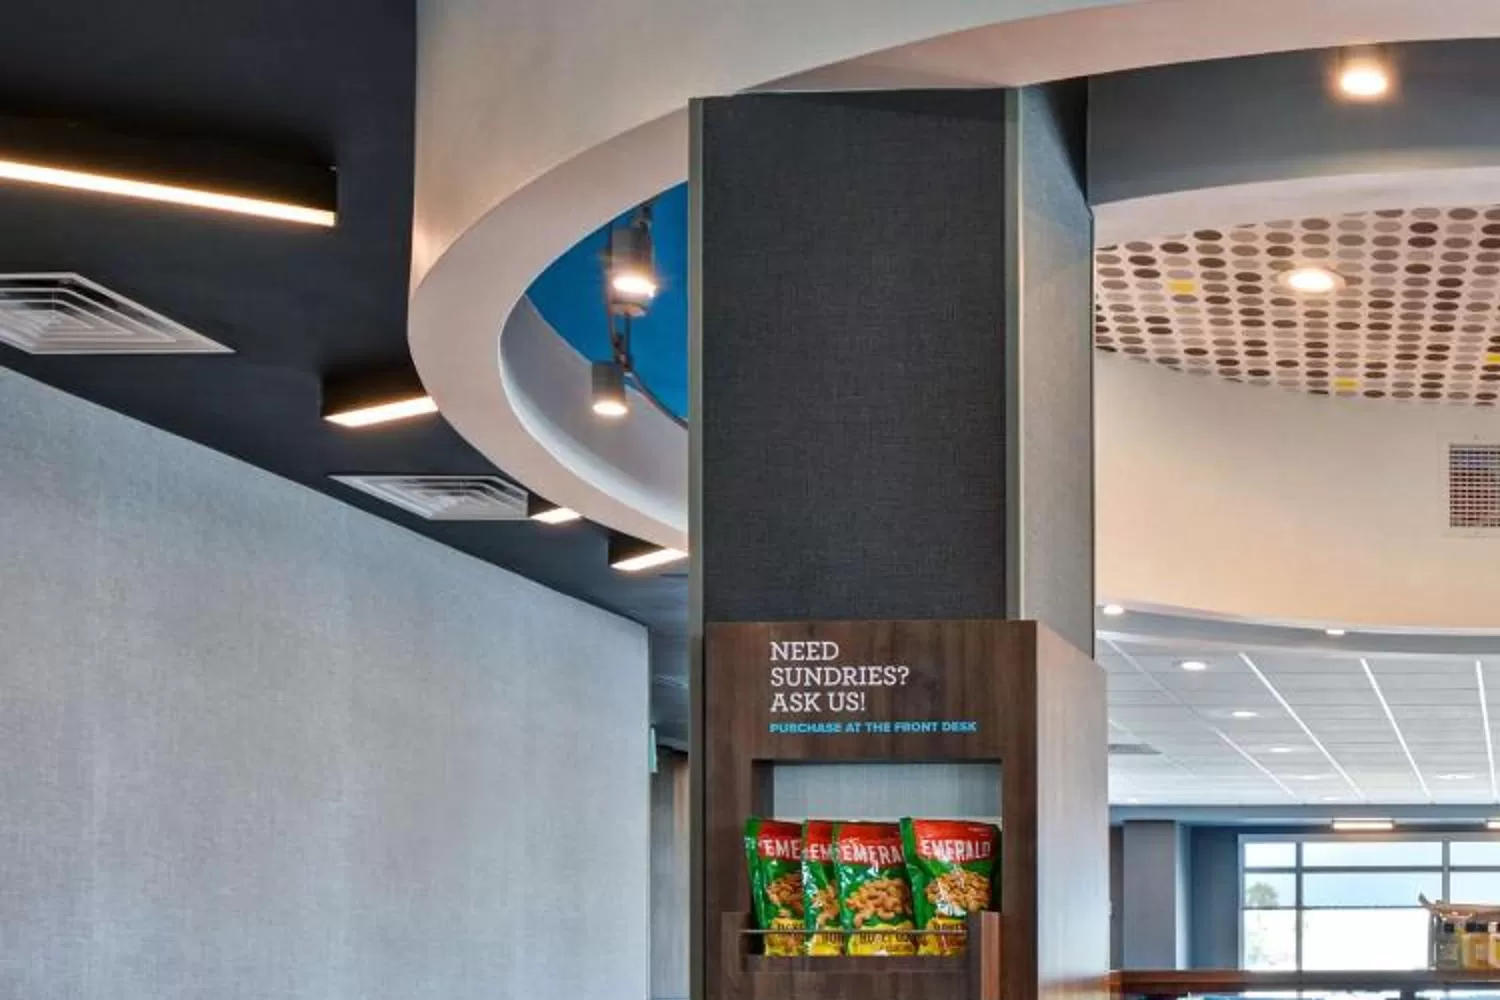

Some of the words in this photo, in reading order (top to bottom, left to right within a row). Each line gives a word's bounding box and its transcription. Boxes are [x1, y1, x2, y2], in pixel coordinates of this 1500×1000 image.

[769, 641, 840, 662] NEED
[770, 665, 910, 687] SUNDRIES?
[769, 692, 822, 713] ASK
[827, 692, 866, 712] US!
[769, 723, 841, 734] PURCHASE
[845, 722, 861, 733] AT
[864, 722, 891, 733] THE
[894, 721, 939, 733] FRONT
[941, 721, 977, 732] DESK
[921, 838, 991, 862] EMERALD
